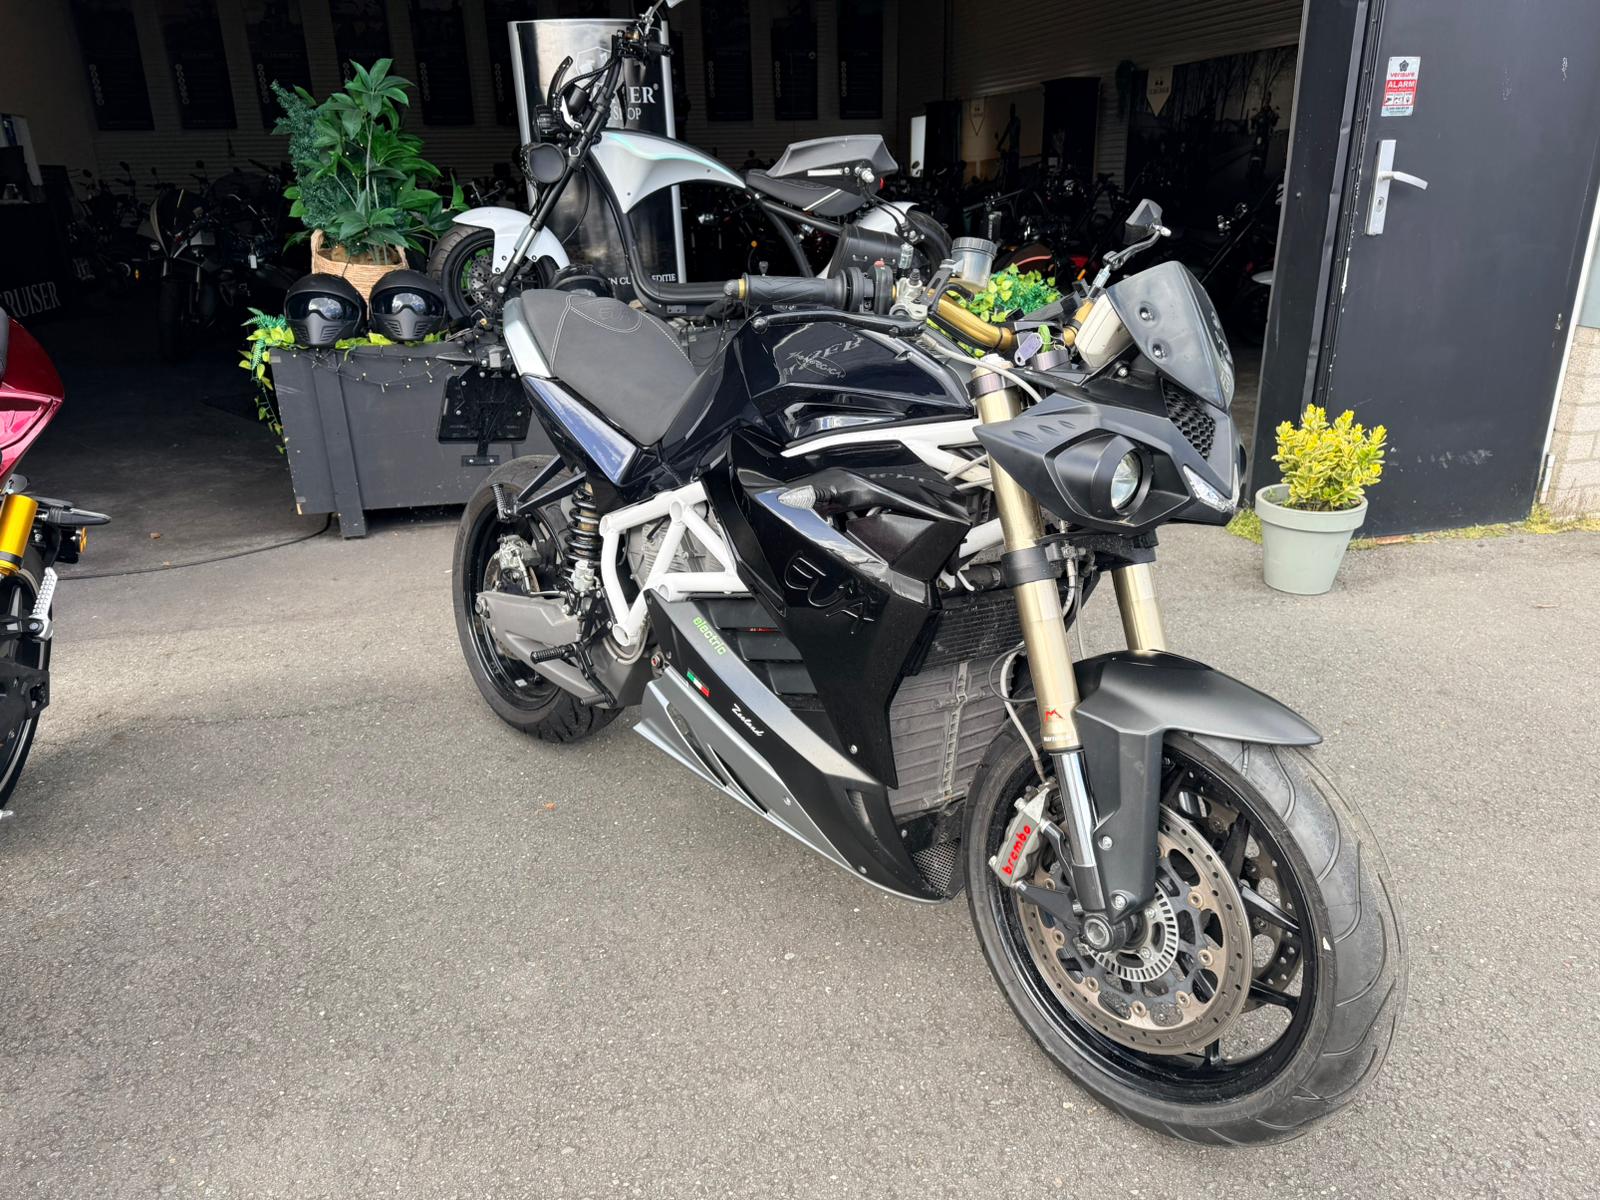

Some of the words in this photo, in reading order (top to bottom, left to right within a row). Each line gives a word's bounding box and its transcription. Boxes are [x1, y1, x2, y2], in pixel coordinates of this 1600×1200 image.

[1387, 80, 1416, 88] ALARM
[0, 281, 62, 318] RUISER
[693, 616, 727, 656] electric
[1001, 824, 1032, 877] brembo
